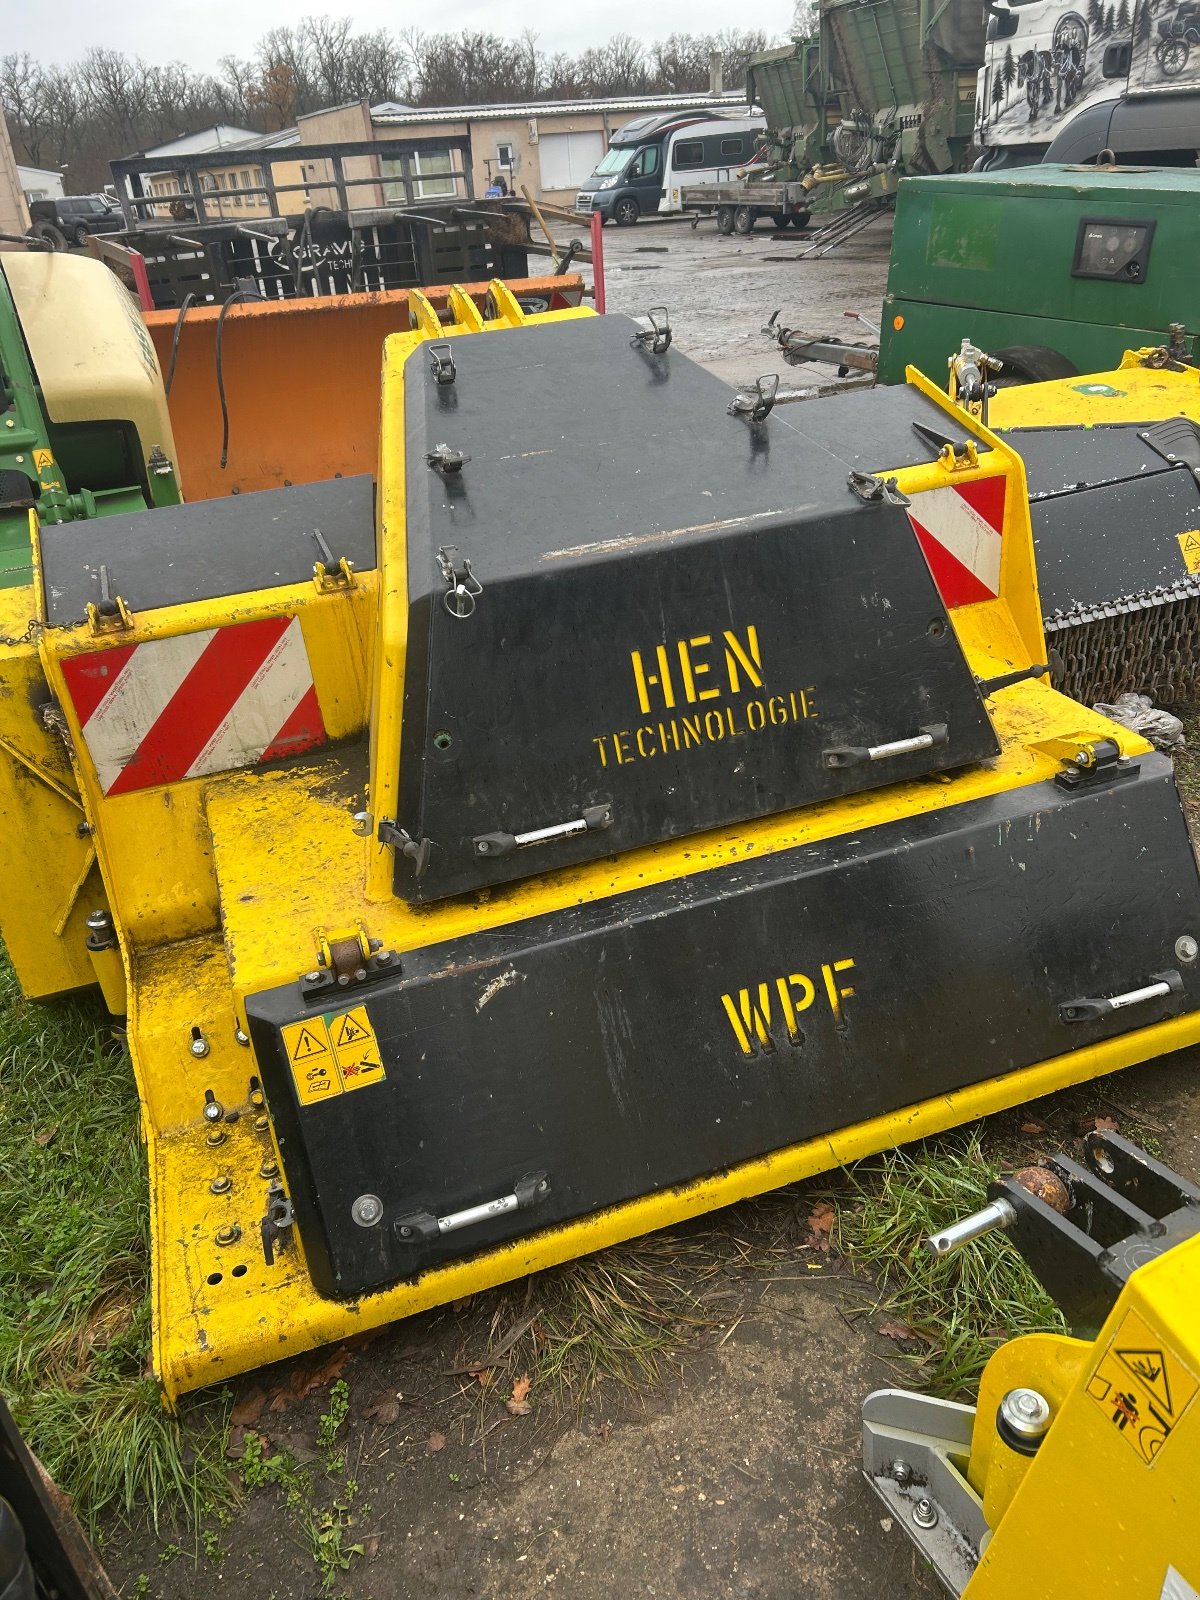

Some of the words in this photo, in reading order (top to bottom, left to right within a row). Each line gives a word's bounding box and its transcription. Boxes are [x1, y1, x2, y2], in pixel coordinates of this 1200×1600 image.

[278, 240, 365, 261] GRAVI
[631, 624, 765, 714] HEN
[592, 685, 820, 767] TECHNOLOGIE
[720, 957, 856, 1057] WPF
